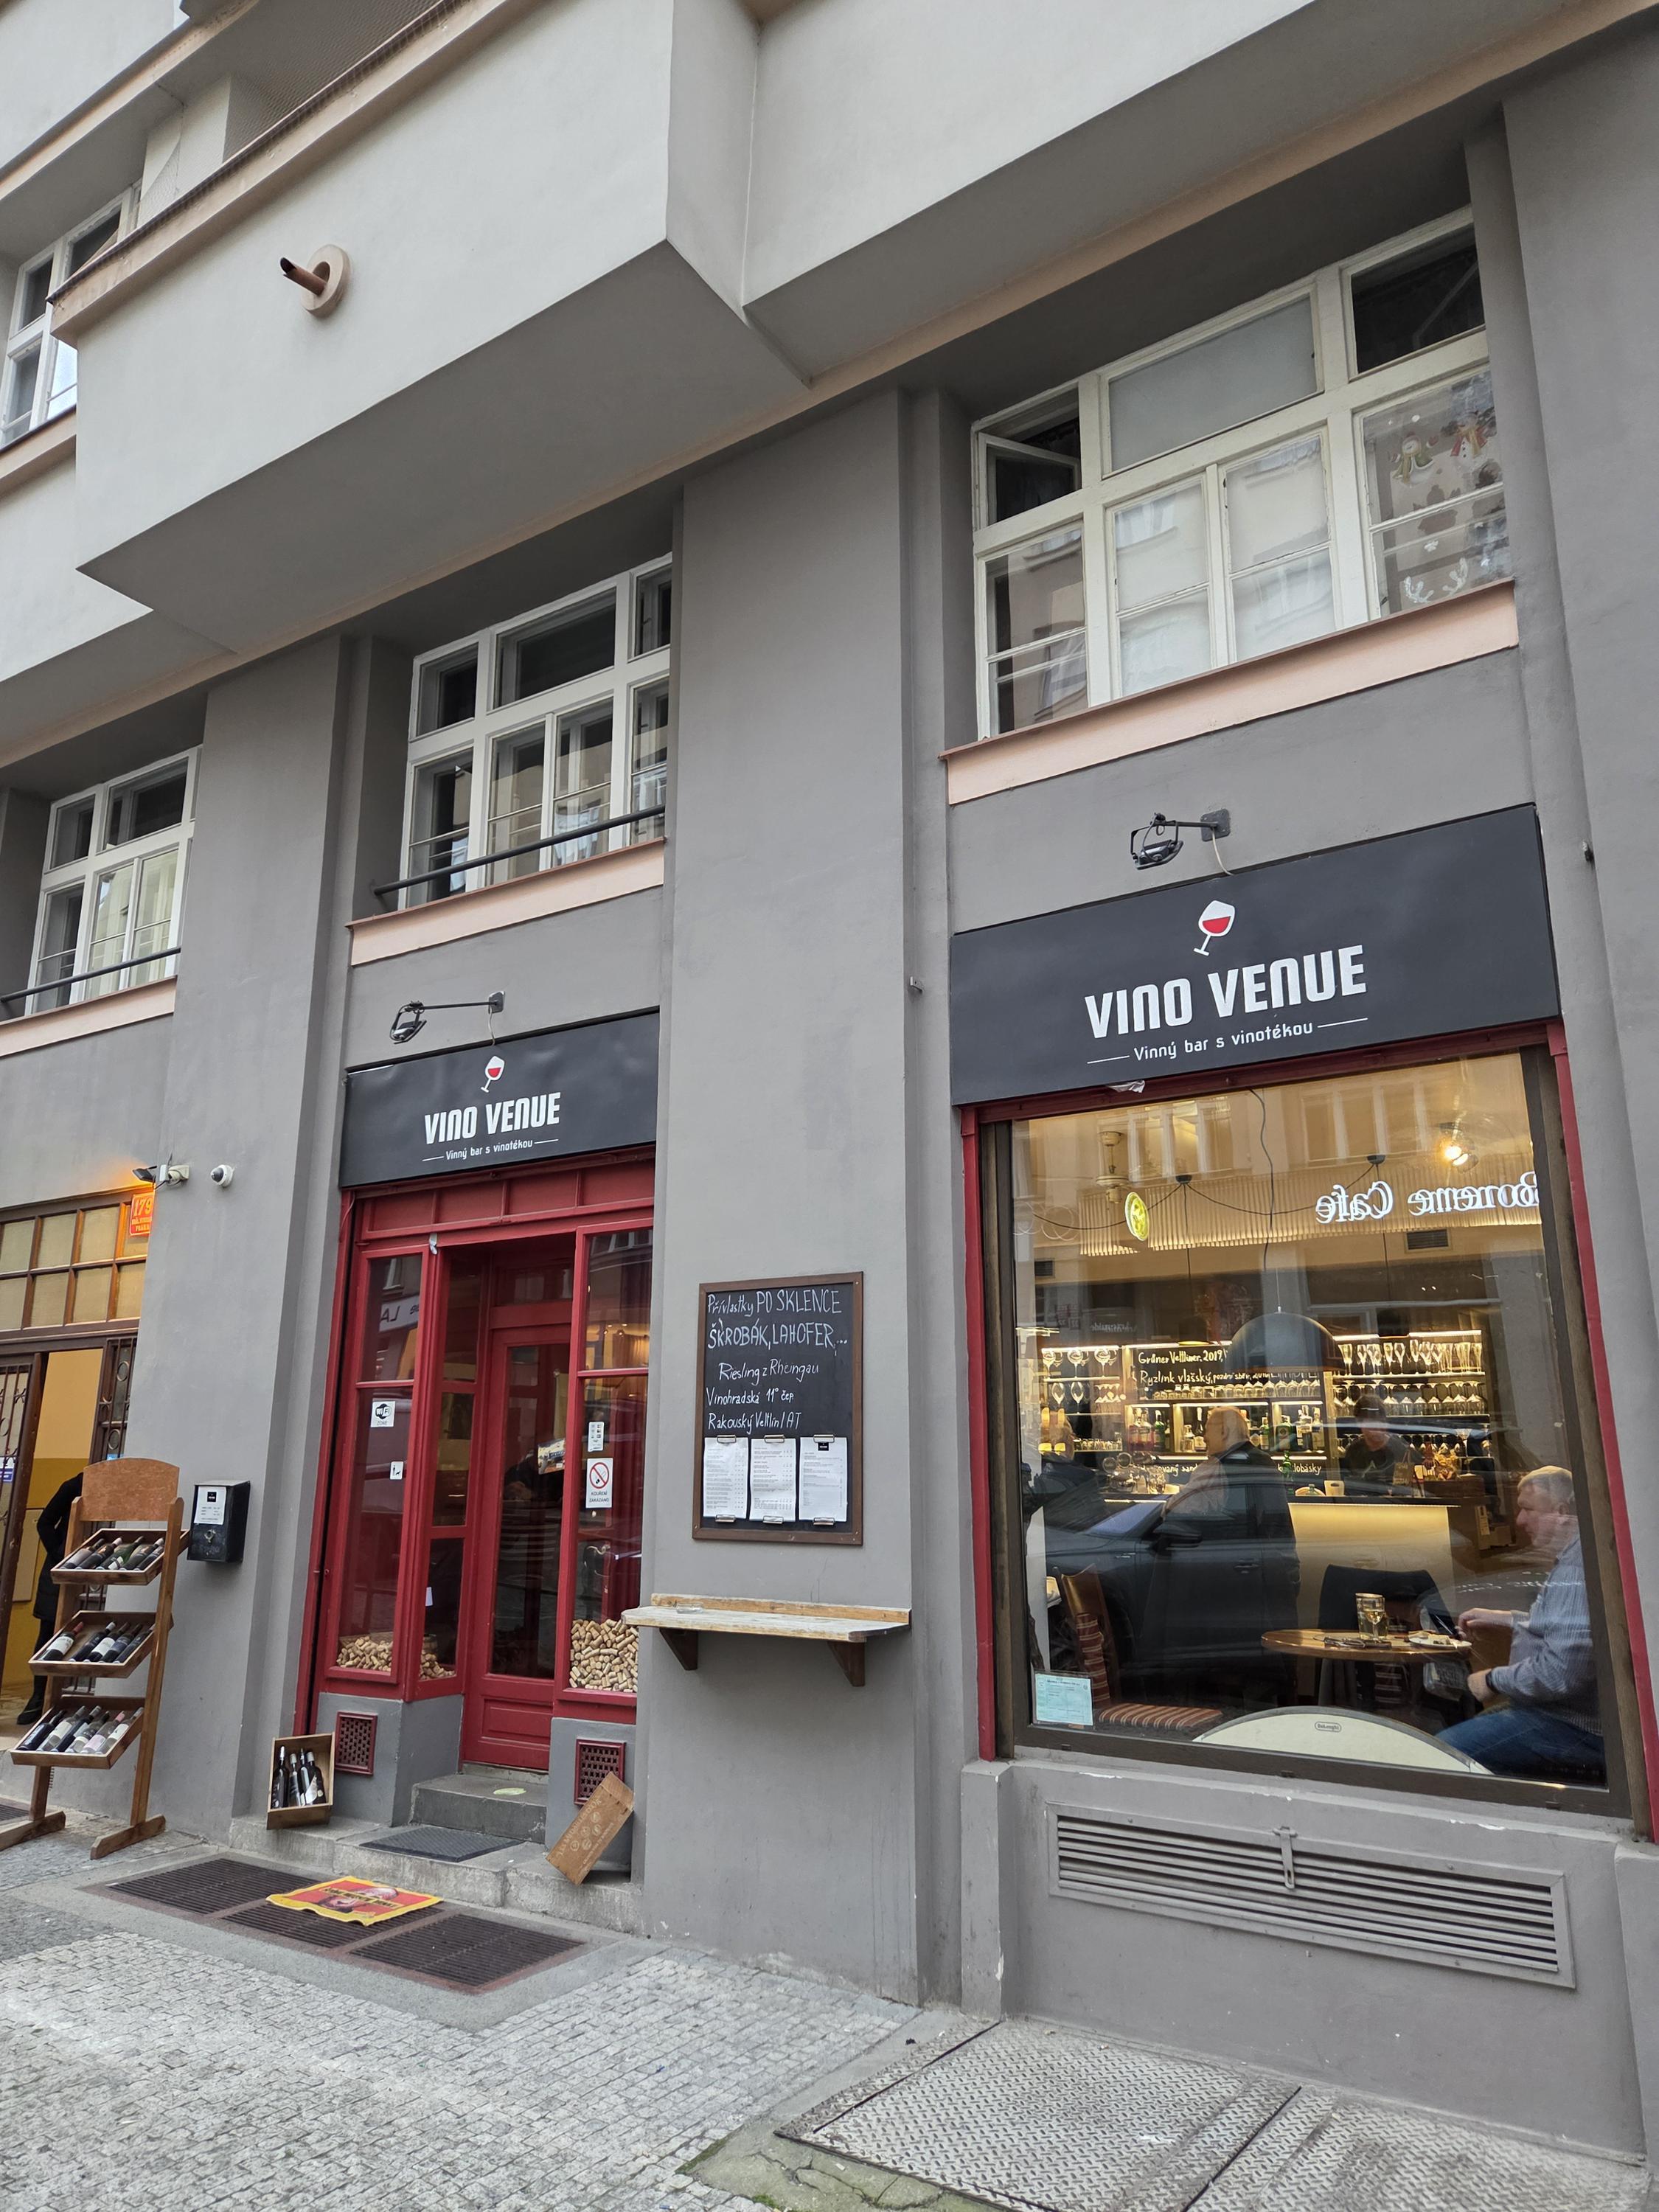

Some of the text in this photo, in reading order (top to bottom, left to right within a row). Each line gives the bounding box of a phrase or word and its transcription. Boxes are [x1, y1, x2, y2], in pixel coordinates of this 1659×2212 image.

[1084, 945, 1367, 1038] VINO VENUE
[1134, 1023, 1313, 1061] Vinný bar s vinotékou
[424, 1092, 561, 1144] VINO VENUE
[445, 1139, 533, 1161] Vinný bar s vinotékou
[707, 1289, 842, 1318] Přívlastky PO SKLENCE
[718, 1358, 819, 1386] Riesling z Rheingau
[1140, 1370, 1175, 1386] Ryzlink
[706, 1387, 760, 1406] Vinohradská
[708, 1412, 754, 1435] Rakouský
